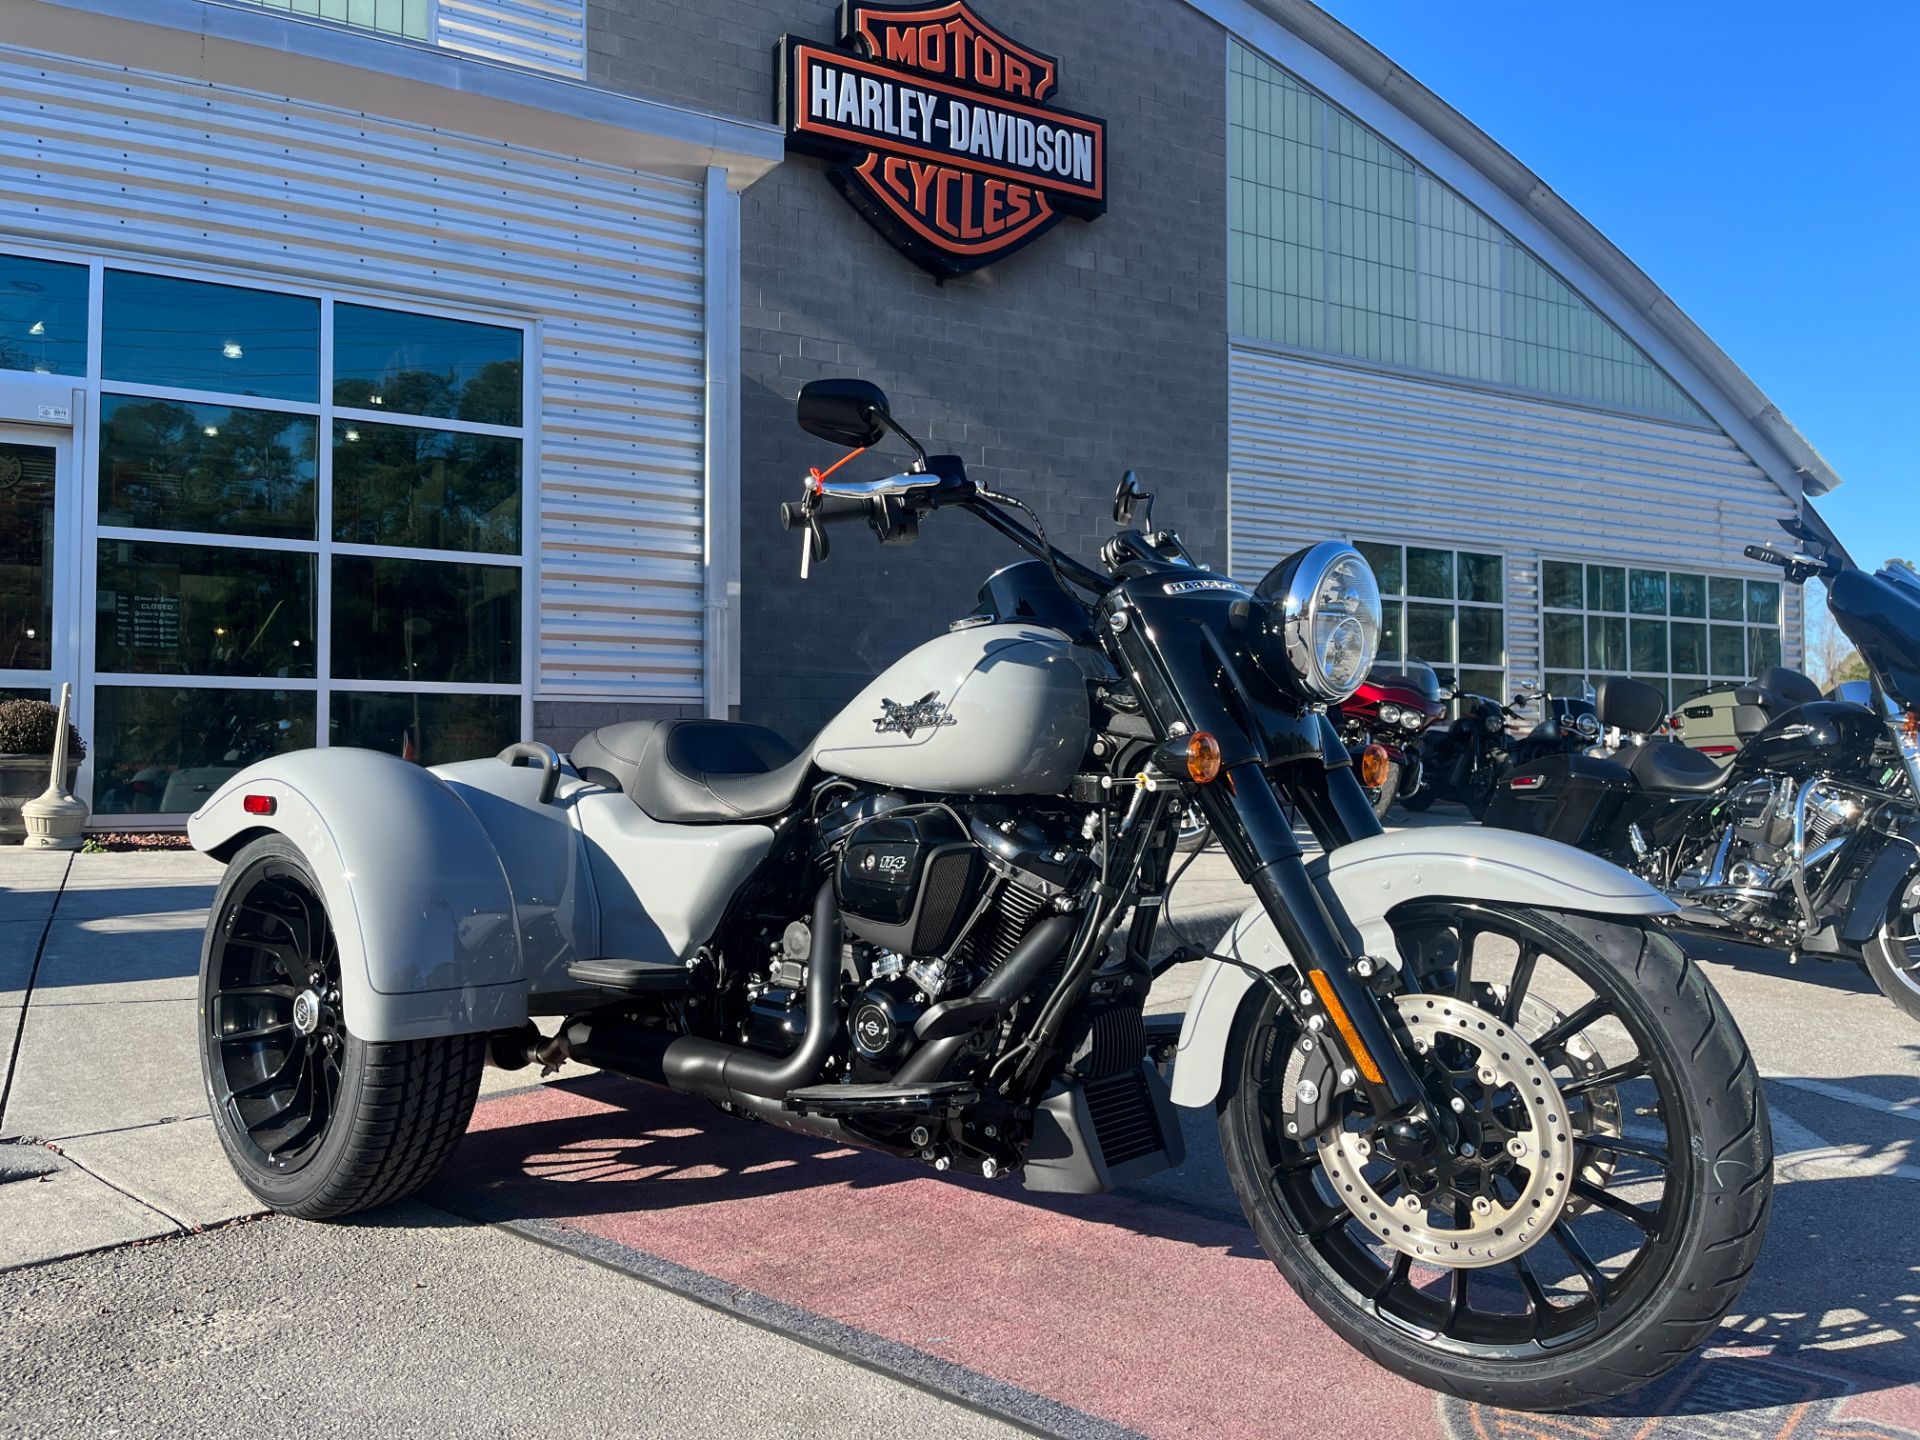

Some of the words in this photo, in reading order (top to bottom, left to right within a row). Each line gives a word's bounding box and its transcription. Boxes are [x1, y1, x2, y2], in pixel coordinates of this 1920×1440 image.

[886, 18, 1032, 98] MOTOR
[811, 64, 1092, 183] HARLEY-DAVIDSON
[884, 156, 1031, 239] CYCLES
[140, 603, 174, 611] CLOSED
[879, 855, 907, 869] 114
